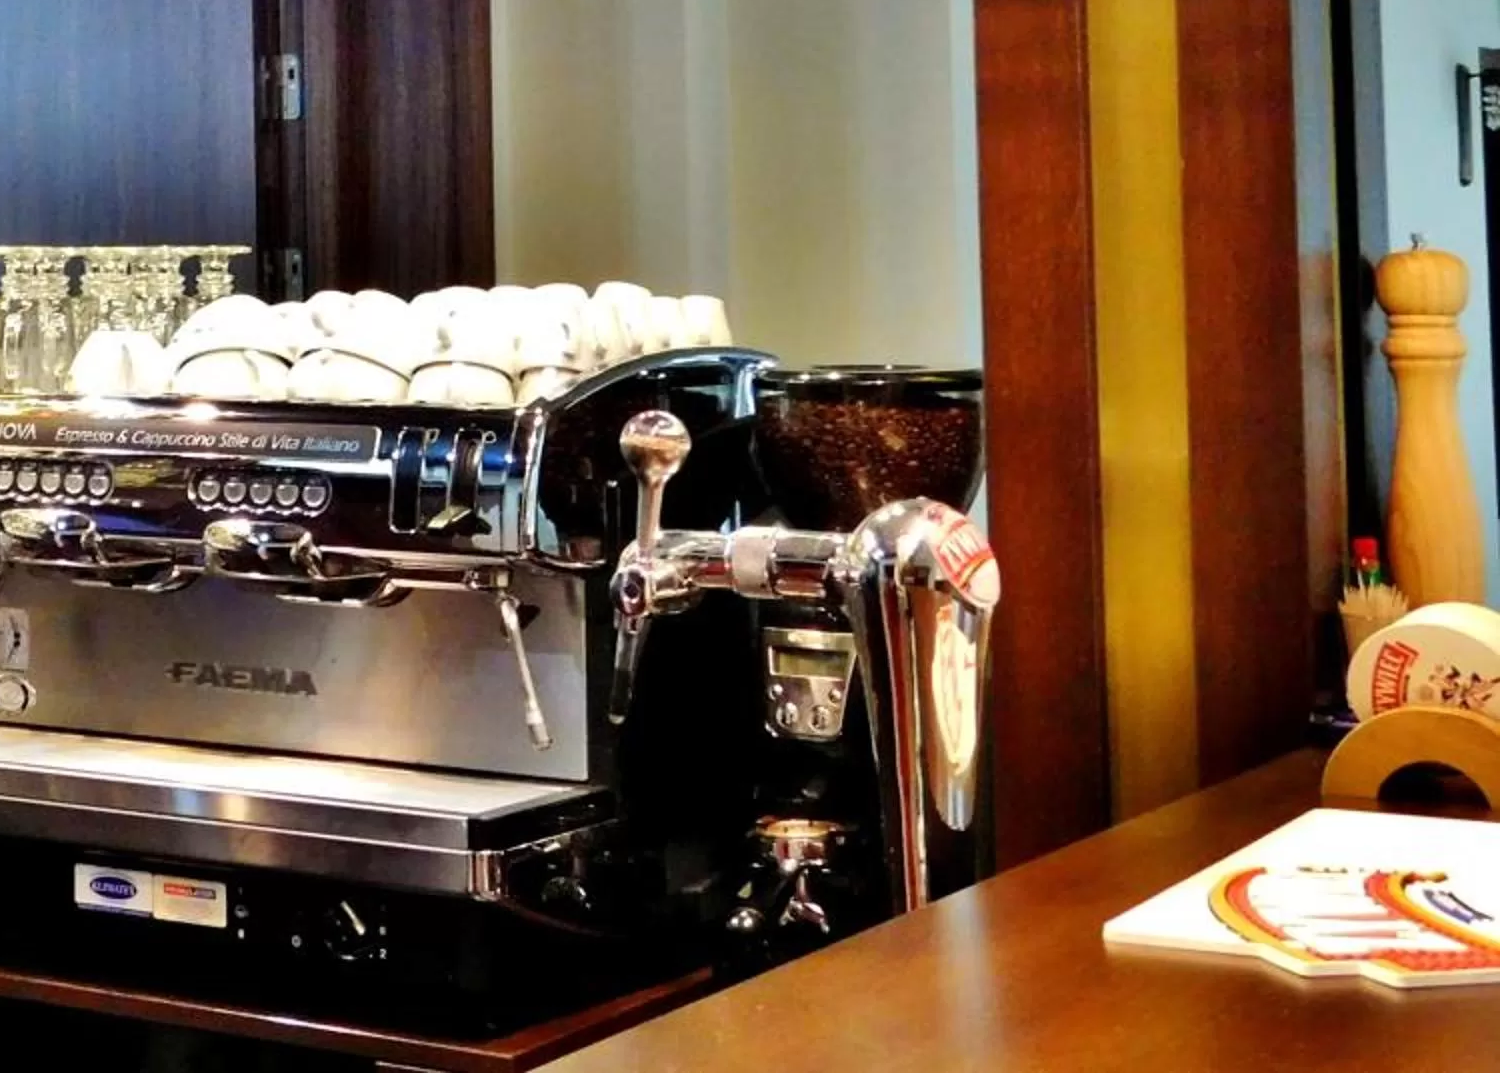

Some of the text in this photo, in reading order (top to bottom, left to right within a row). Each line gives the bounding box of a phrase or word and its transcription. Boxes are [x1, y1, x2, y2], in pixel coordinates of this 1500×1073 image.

[55, 426, 114, 444] Espresso
[131, 429, 216, 448] Cappuccino
[218, 432, 249, 448] Stile
[270, 434, 300, 451] Vita
[302, 436, 361, 453] Italiano
[168, 661, 318, 696] FAEMA
[1374, 646, 1406, 713] YWIEC
